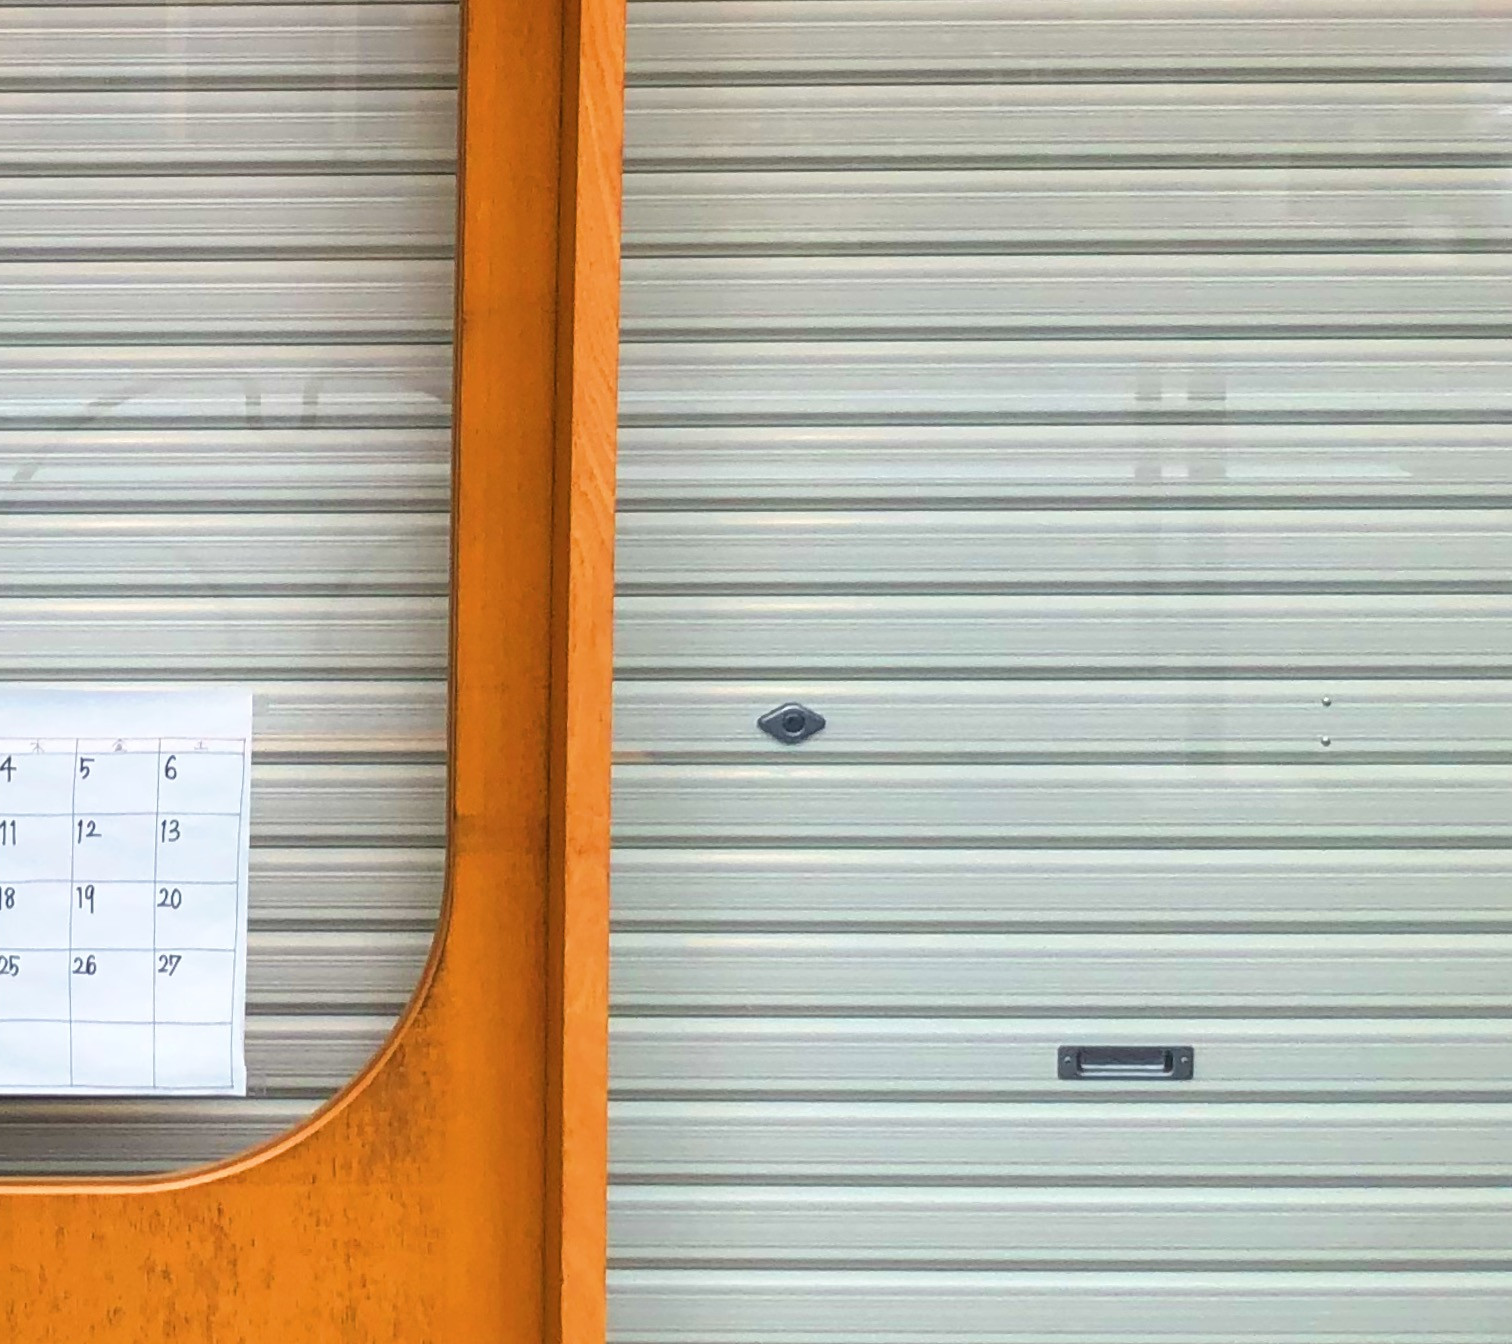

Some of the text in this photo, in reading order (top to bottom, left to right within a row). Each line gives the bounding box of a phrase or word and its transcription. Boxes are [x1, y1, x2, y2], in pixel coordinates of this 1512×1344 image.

[0, 756, 16, 782] 4
[80, 757, 94, 779] 5
[164, 754, 177, 780] 6
[0, 820, 16, 846] 11
[78, 819, 102, 844] 12
[161, 820, 180, 843] 13
[76, 885, 94, 914] 19
[157, 888, 182, 909] 20
[72, 954, 97, 975] 26
[158, 954, 182, 976] 27
